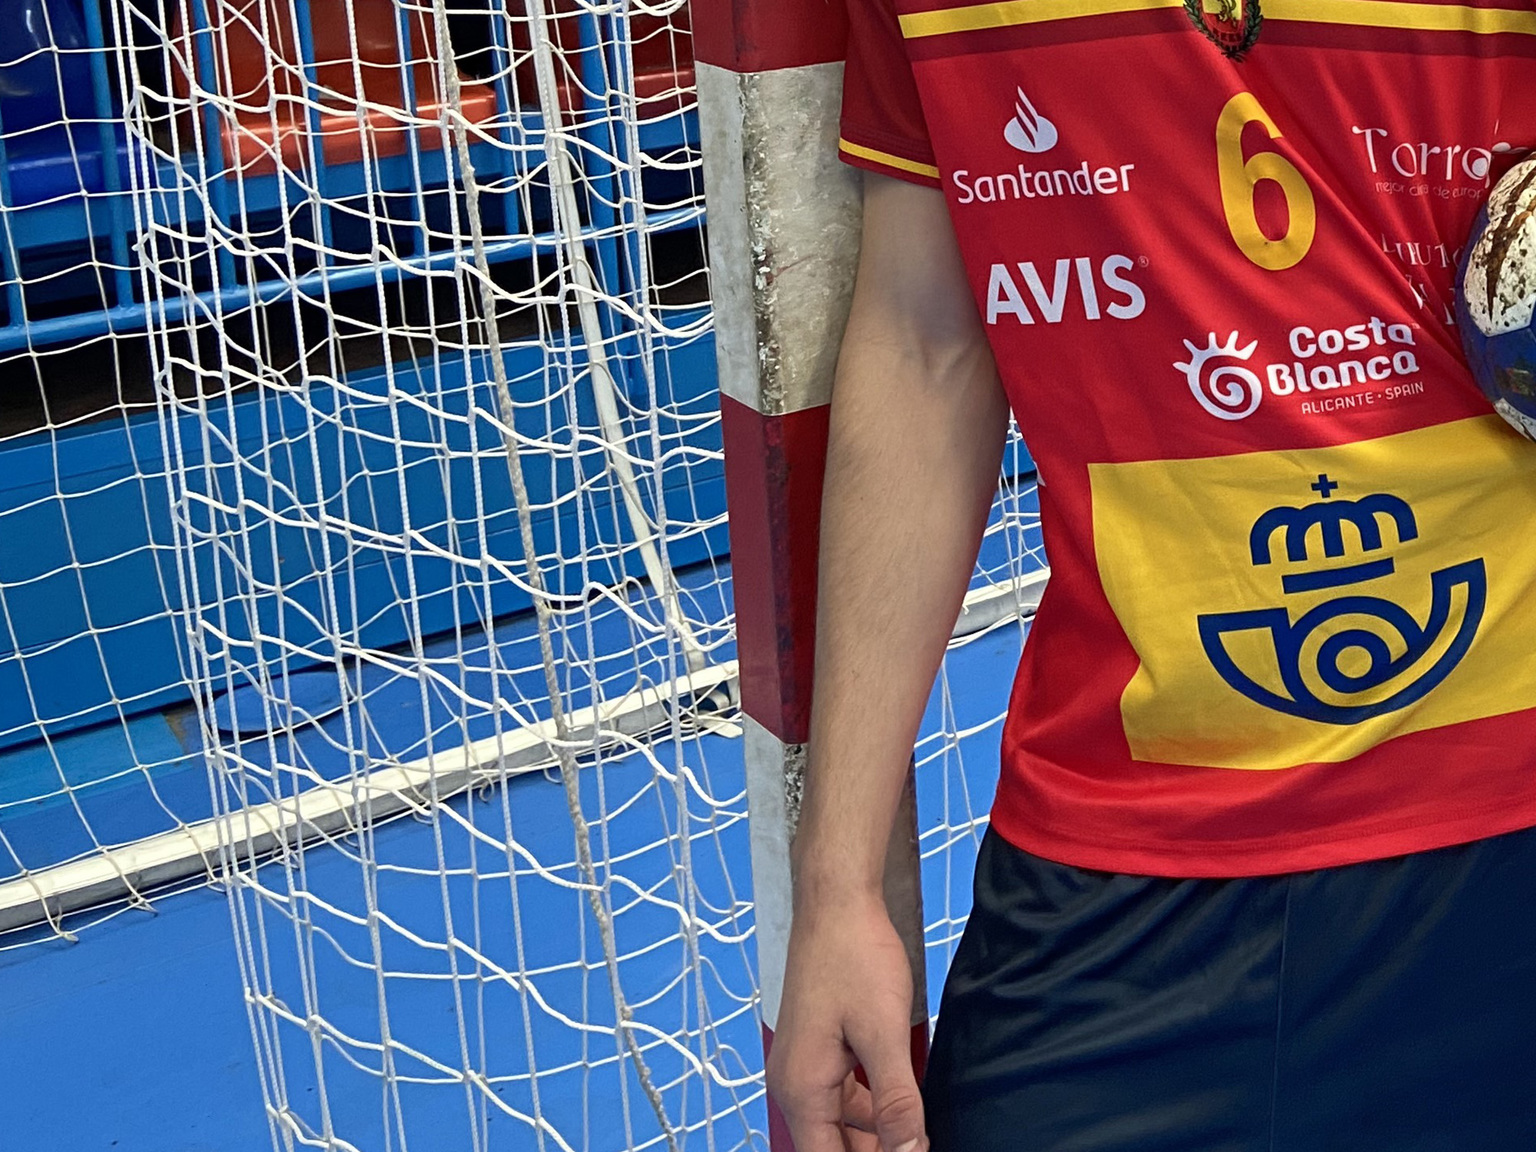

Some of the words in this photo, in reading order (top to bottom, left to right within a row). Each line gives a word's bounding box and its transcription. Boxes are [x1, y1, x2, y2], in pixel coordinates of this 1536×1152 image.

[952, 160, 1135, 204] Santander
[1215, 91, 1317, 271] 6
[986, 253, 1147, 325] AVIS
[1289, 316, 1416, 358] Costa
[1266, 350, 1420, 396] Blanca
[1301, 393, 1374, 415] ALICANTE
[1385, 382, 1425, 400] SPAIN
